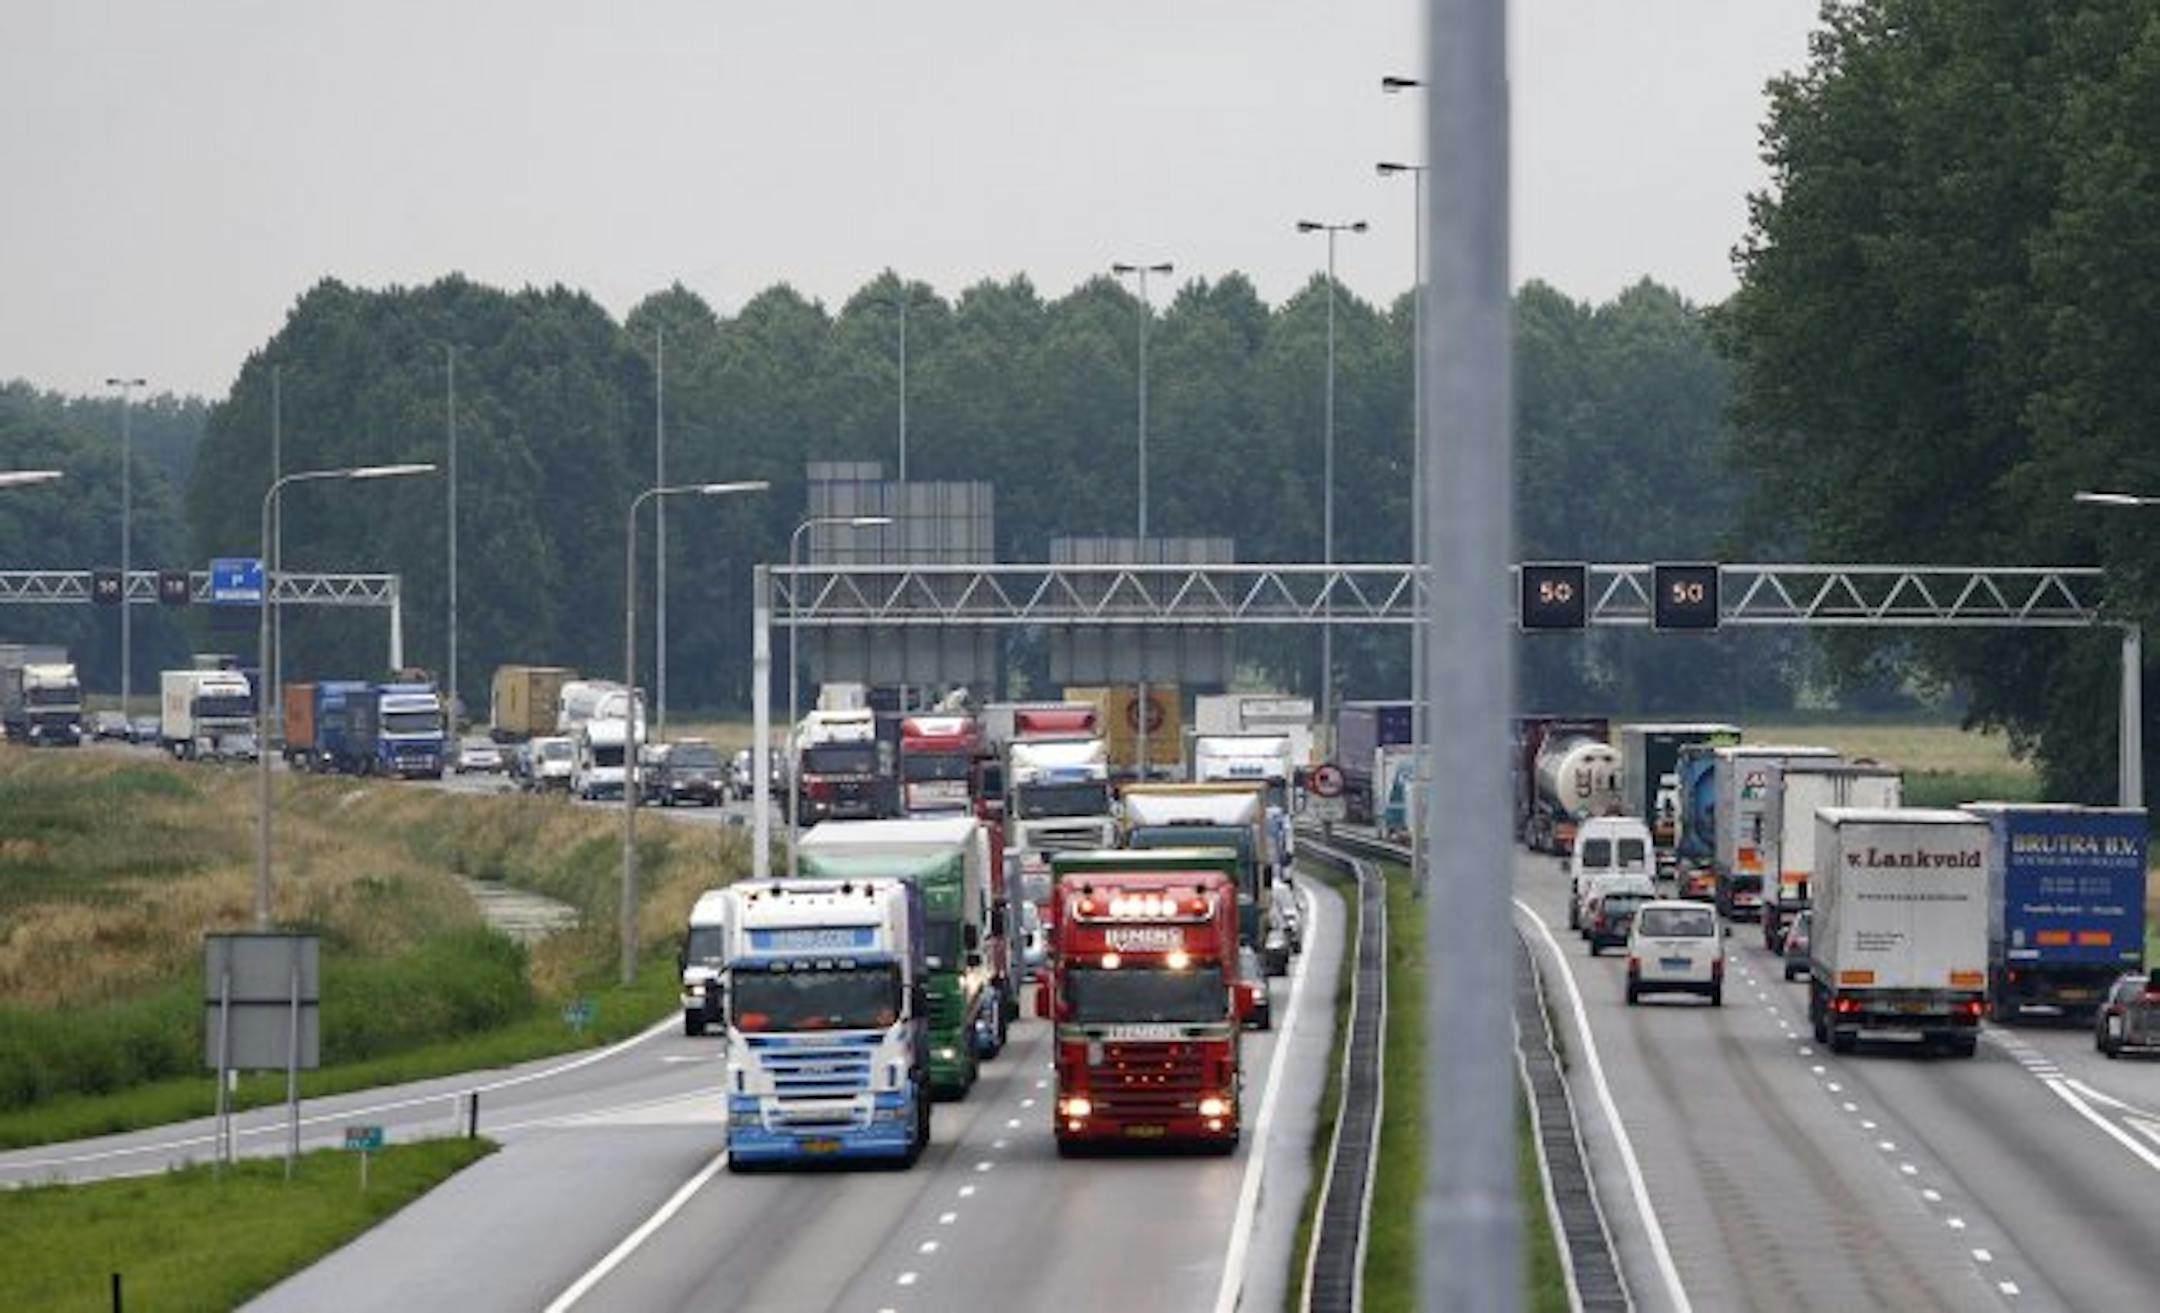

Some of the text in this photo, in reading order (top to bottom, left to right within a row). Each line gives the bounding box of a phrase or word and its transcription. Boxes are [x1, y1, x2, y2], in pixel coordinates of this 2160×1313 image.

[1539, 580, 1573, 604] 50
[1672, 580, 1704, 603] 50
[1867, 848, 1981, 868] Lankveld
